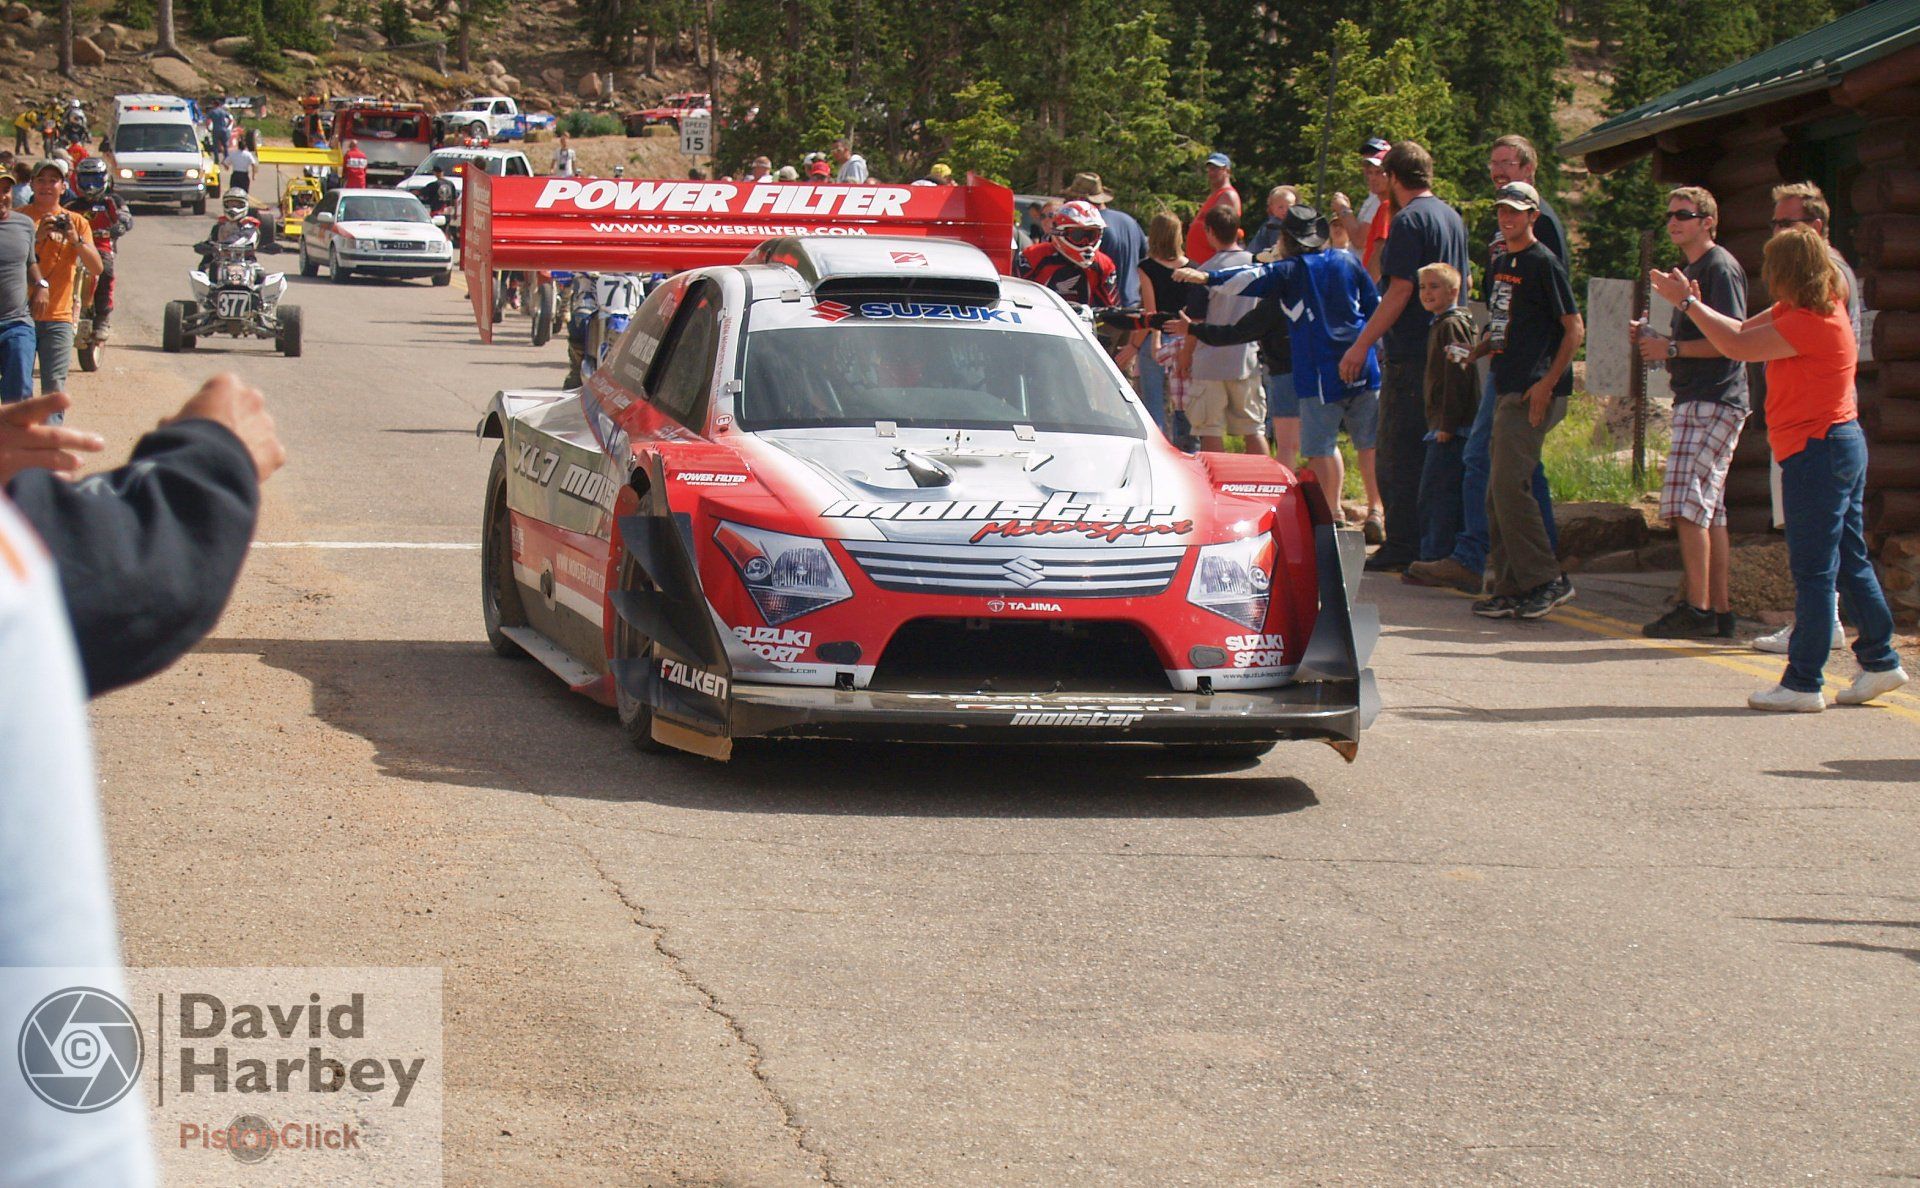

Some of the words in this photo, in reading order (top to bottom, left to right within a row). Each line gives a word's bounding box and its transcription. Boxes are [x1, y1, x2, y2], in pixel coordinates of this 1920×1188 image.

[686, 136, 704, 151] 15
[534, 179, 737, 213] POWER
[742, 184, 912, 217] FILTER
[590, 222, 868, 238] WWW.POWERFILTER.COM
[604, 280, 633, 309] 71
[219, 293, 249, 318] 377
[860, 302, 1022, 325] SUZUKI
[514, 441, 560, 488] XL7
[676, 472, 714, 482] POWER
[714, 473, 747, 483] FILTER
[1221, 484, 1258, 493] POWER
[1257, 485, 1287, 494] FILTER
[1008, 601, 1062, 612] TAJIMA
[732, 626, 812, 647] SUZUKI
[1225, 634, 1284, 652] SUZUKI
[744, 643, 805, 663] PORT
[1233, 651, 1284, 669] SPORT
[660, 658, 728, 700] FALKEN
